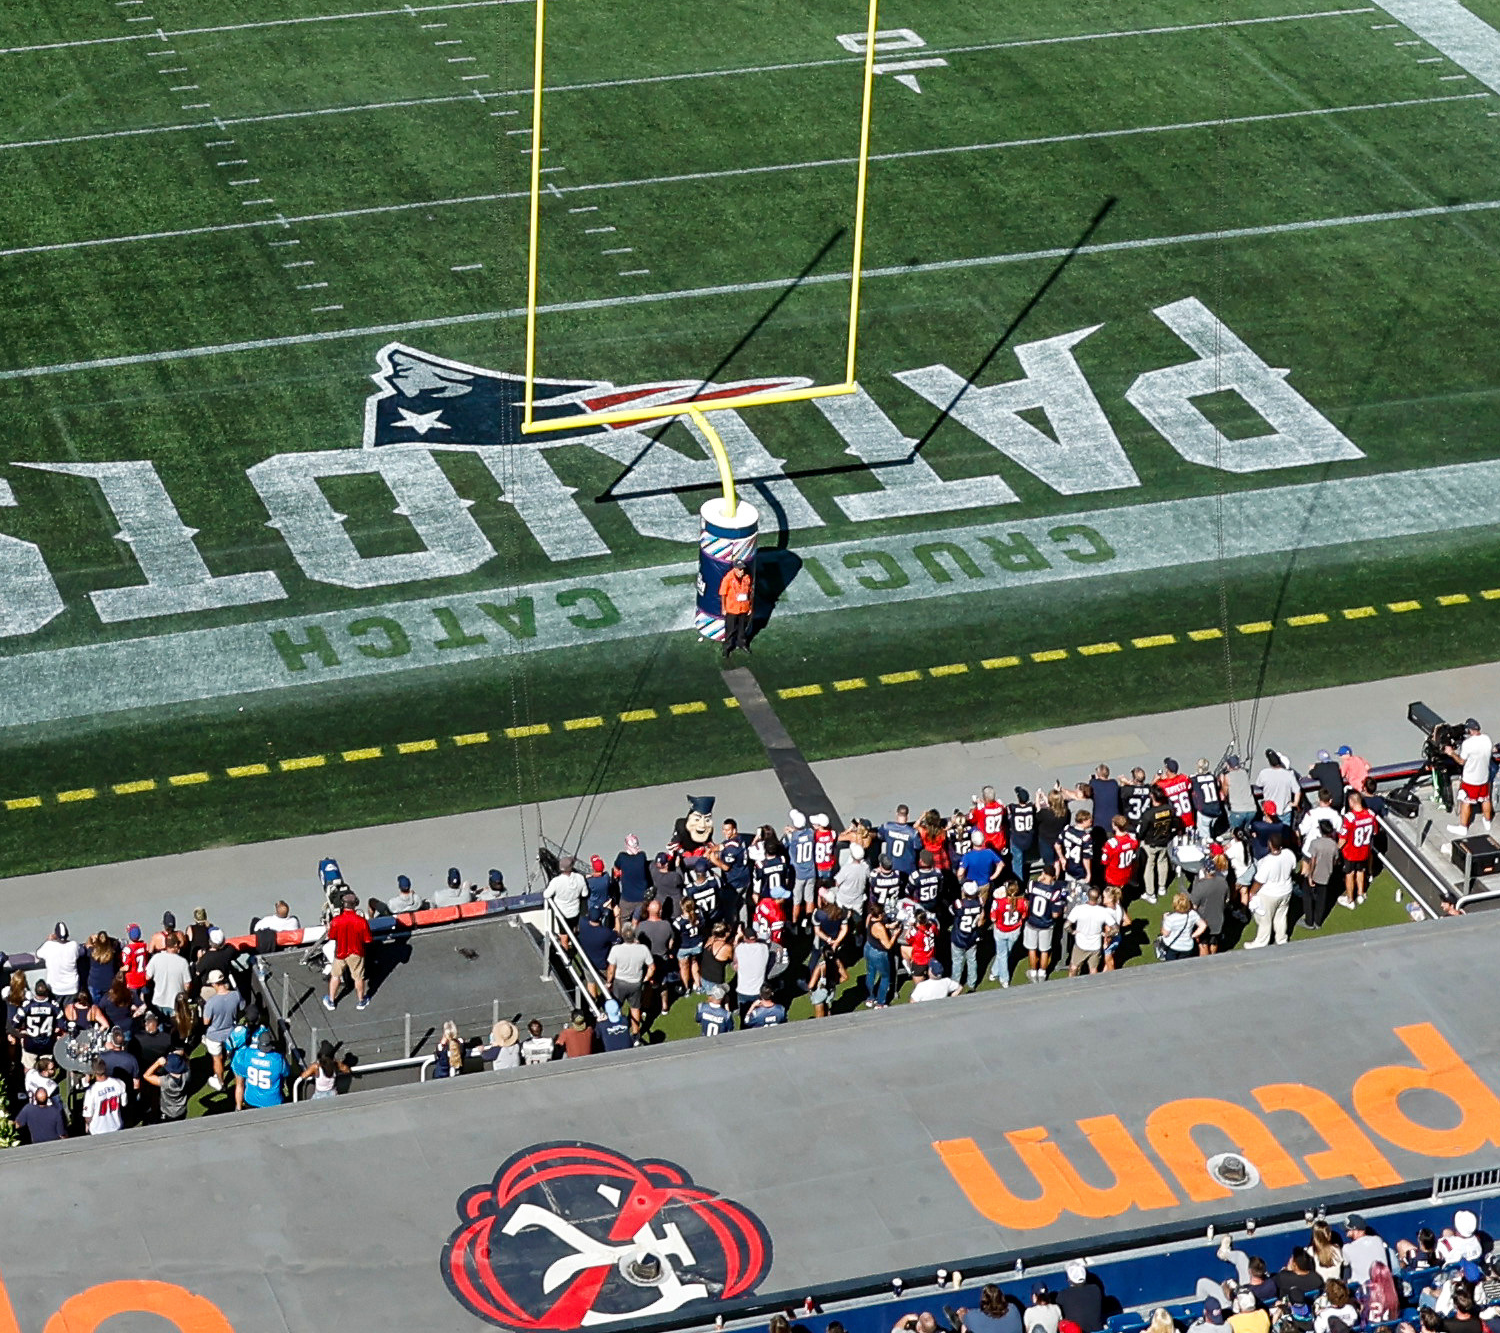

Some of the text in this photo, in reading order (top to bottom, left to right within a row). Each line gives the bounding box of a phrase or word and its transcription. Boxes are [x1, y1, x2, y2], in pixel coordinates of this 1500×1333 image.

[272, 586, 622, 673] CATCH
[1353, 825, 1373, 846] 87
[26, 1014, 53, 1036] 54
[246, 1066, 272, 1090] 95
